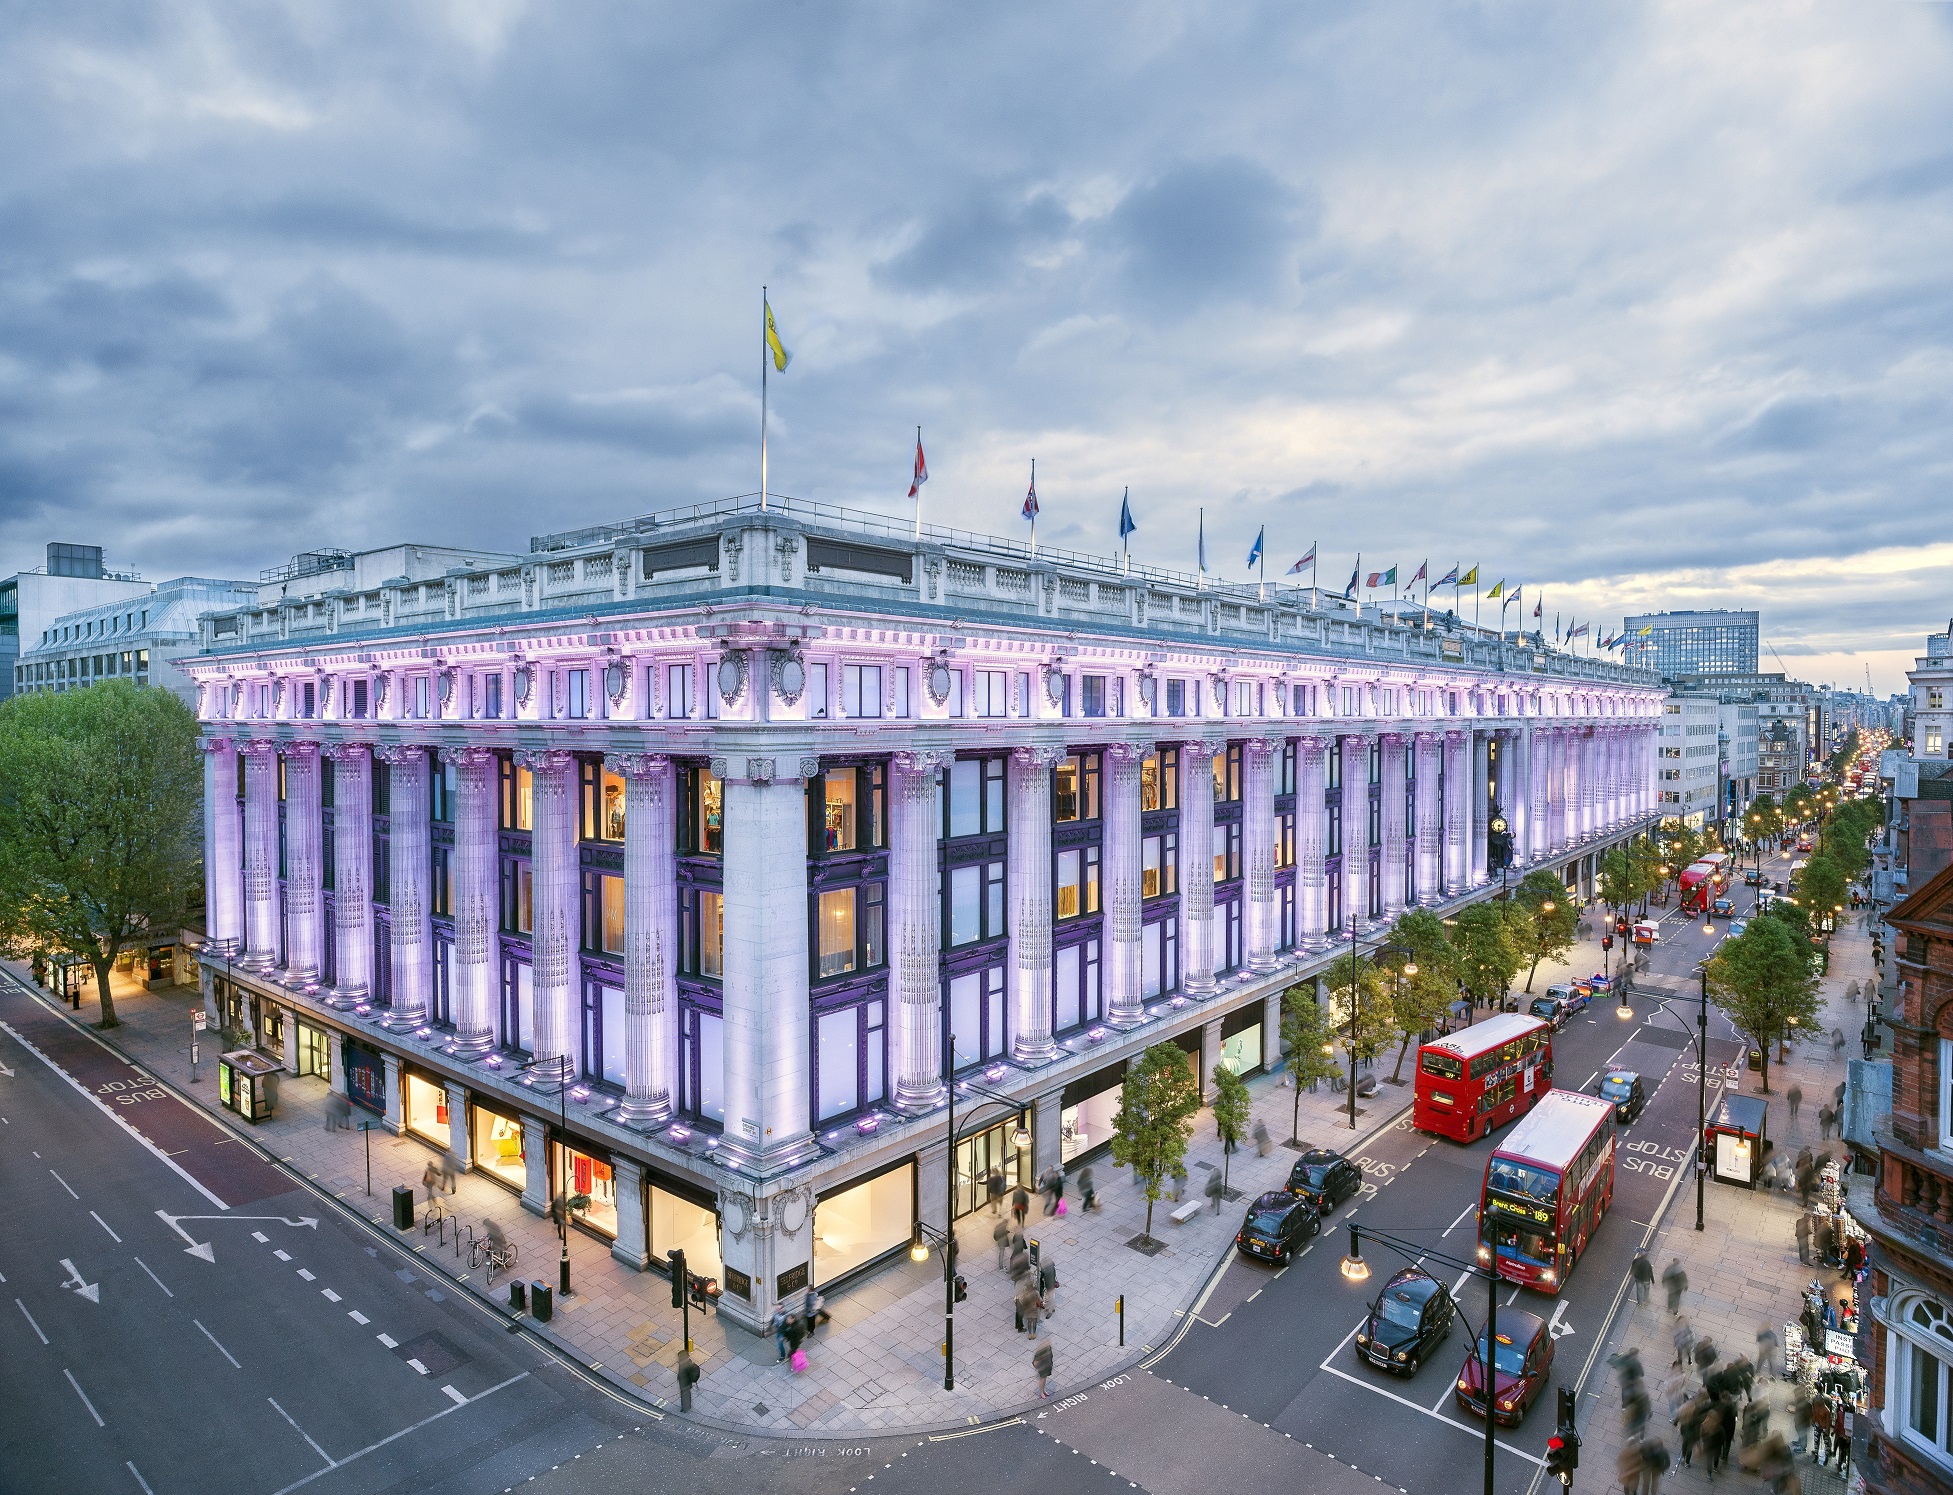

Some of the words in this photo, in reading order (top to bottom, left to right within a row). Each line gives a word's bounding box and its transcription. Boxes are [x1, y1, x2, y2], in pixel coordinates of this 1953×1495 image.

[98, 1077, 156, 1093] STOP
[115, 1089, 167, 1105] BUS
[1627, 1140, 1687, 1162] STOP
[1353, 1157, 1395, 1177] BUS
[1623, 1157, 1674, 1180] BUS
[1493, 1199, 1508, 1210] Brent
[1509, 1204, 1526, 1215] Cross
[1534, 1211, 1549, 1222] 189
[780, 1267, 806, 1286] SELFRIDGE
[1100, 1374, 1131, 1390] LOOK
[1053, 1392, 1088, 1413] RIGHT
[782, 1447, 826, 1457] RIGHT
[838, 1447, 871, 1456] LOOK
